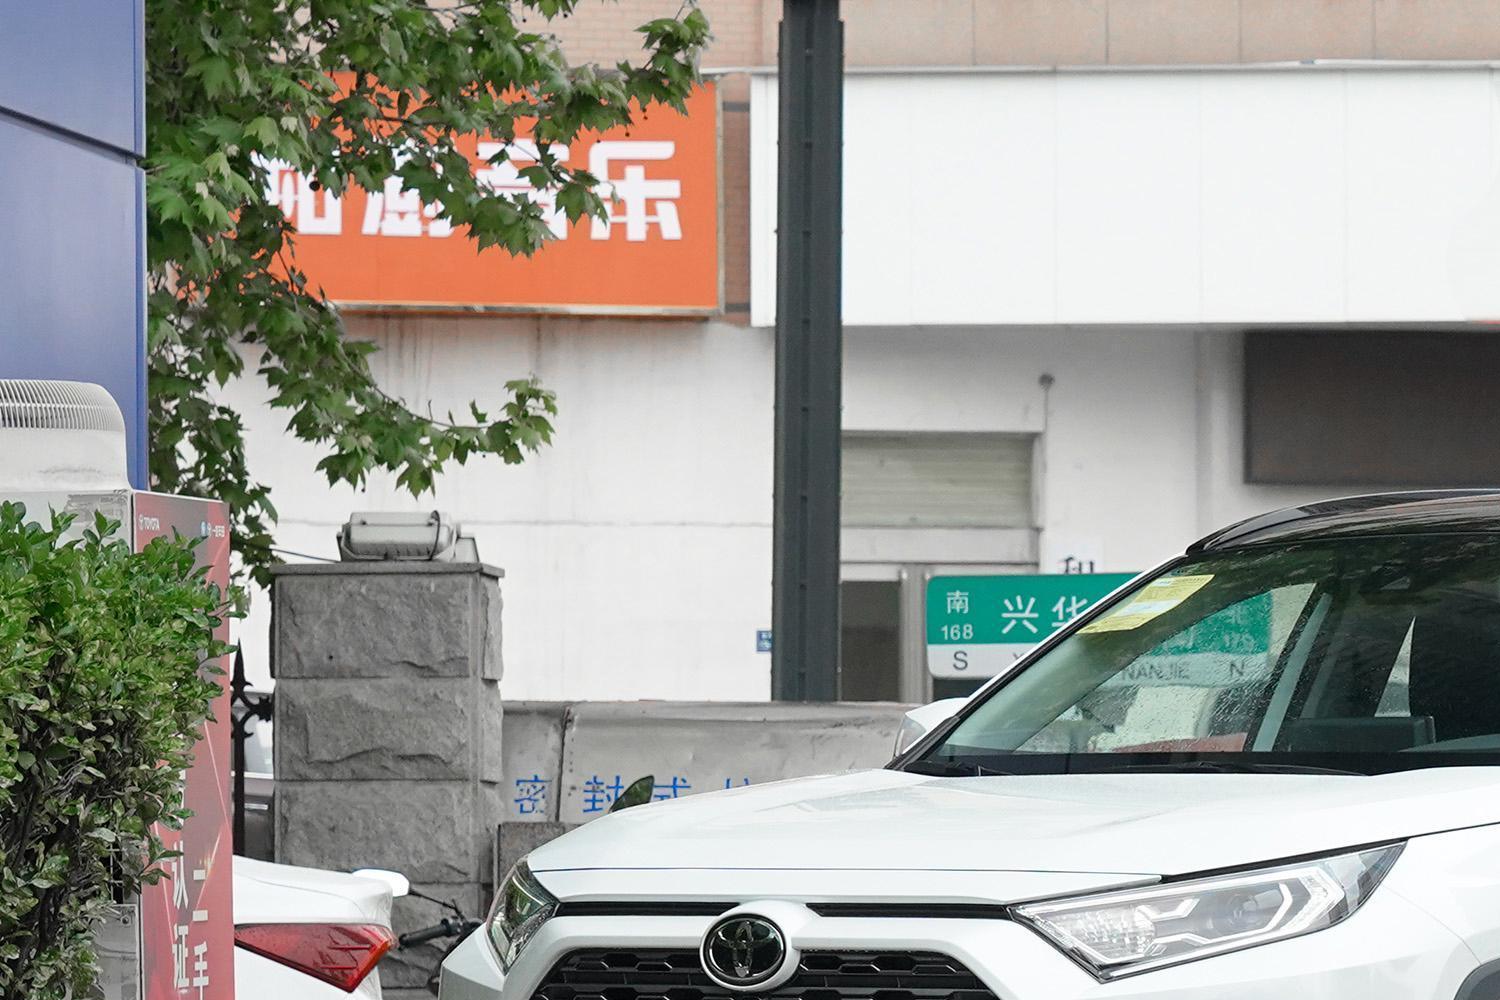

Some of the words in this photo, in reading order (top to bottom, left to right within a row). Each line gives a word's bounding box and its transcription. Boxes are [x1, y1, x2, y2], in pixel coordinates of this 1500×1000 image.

[940, 624, 974, 641] 168
[946, 590, 969, 614] 南
[1001, 594, 1089, 635] 兴华
[952, 650, 969, 671] S
[514, 774, 750, 814] 密封式
[172, 775, 190, 991] 认证
